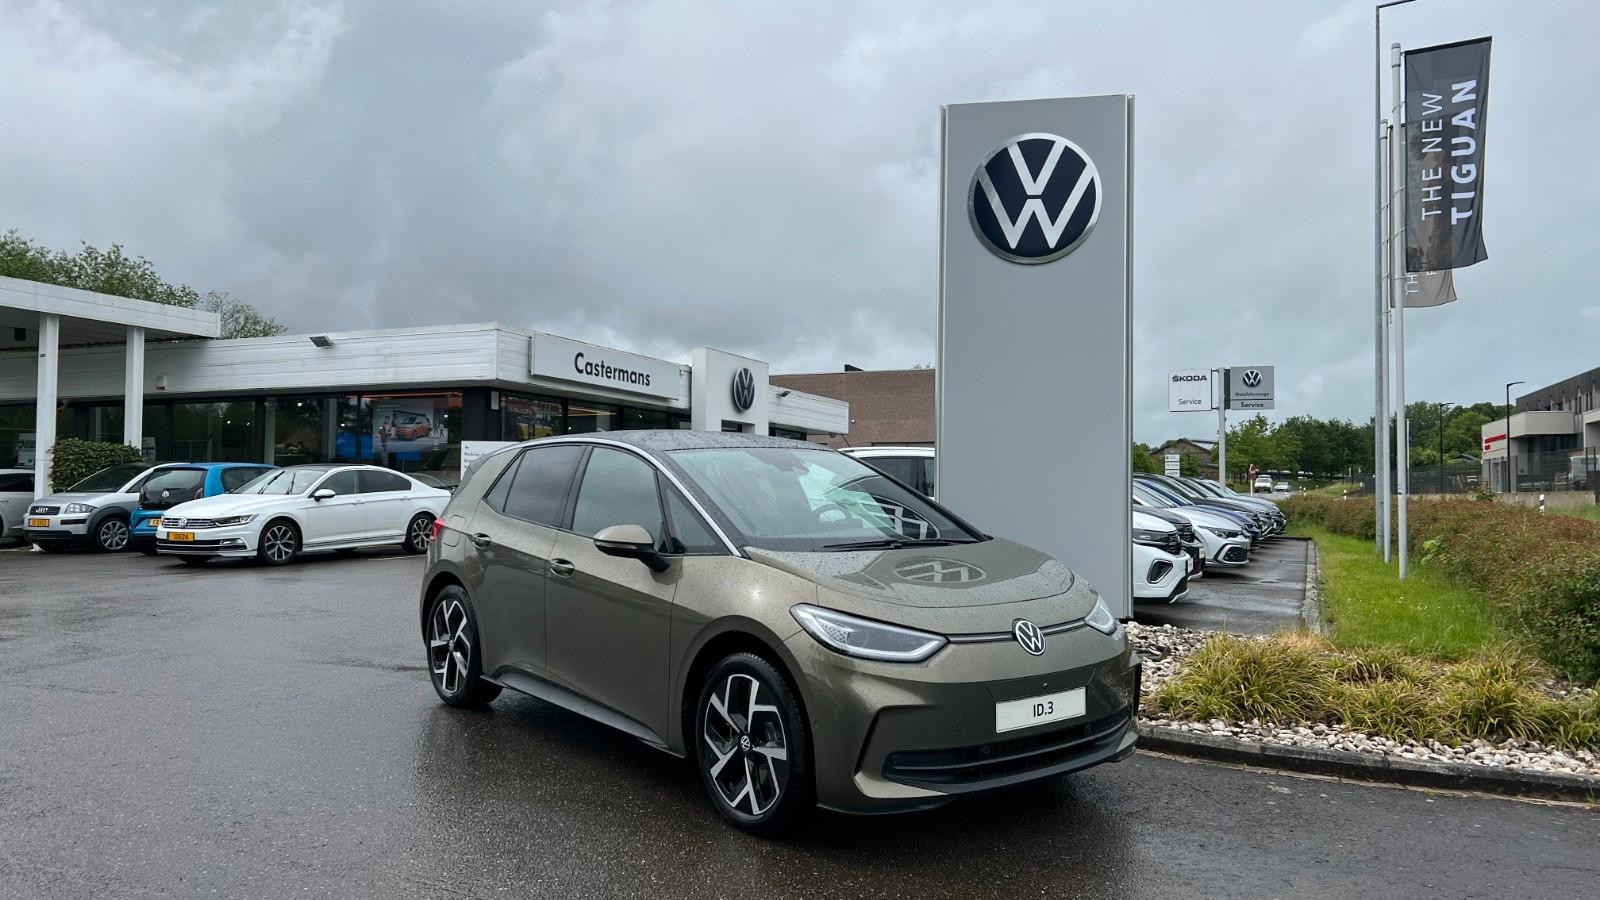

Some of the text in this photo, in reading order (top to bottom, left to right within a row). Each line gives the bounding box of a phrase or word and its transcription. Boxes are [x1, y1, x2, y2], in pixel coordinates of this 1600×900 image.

[1421, 92, 1443, 221] THE NEW
[1450, 79, 1478, 226] TIGUAN
[972, 135, 1098, 255] VW
[1405, 273, 1419, 296] TH
[574, 352, 651, 387] Castermans
[1016, 620, 1045, 655] VW
[1033, 701, 1054, 718] ID.3
